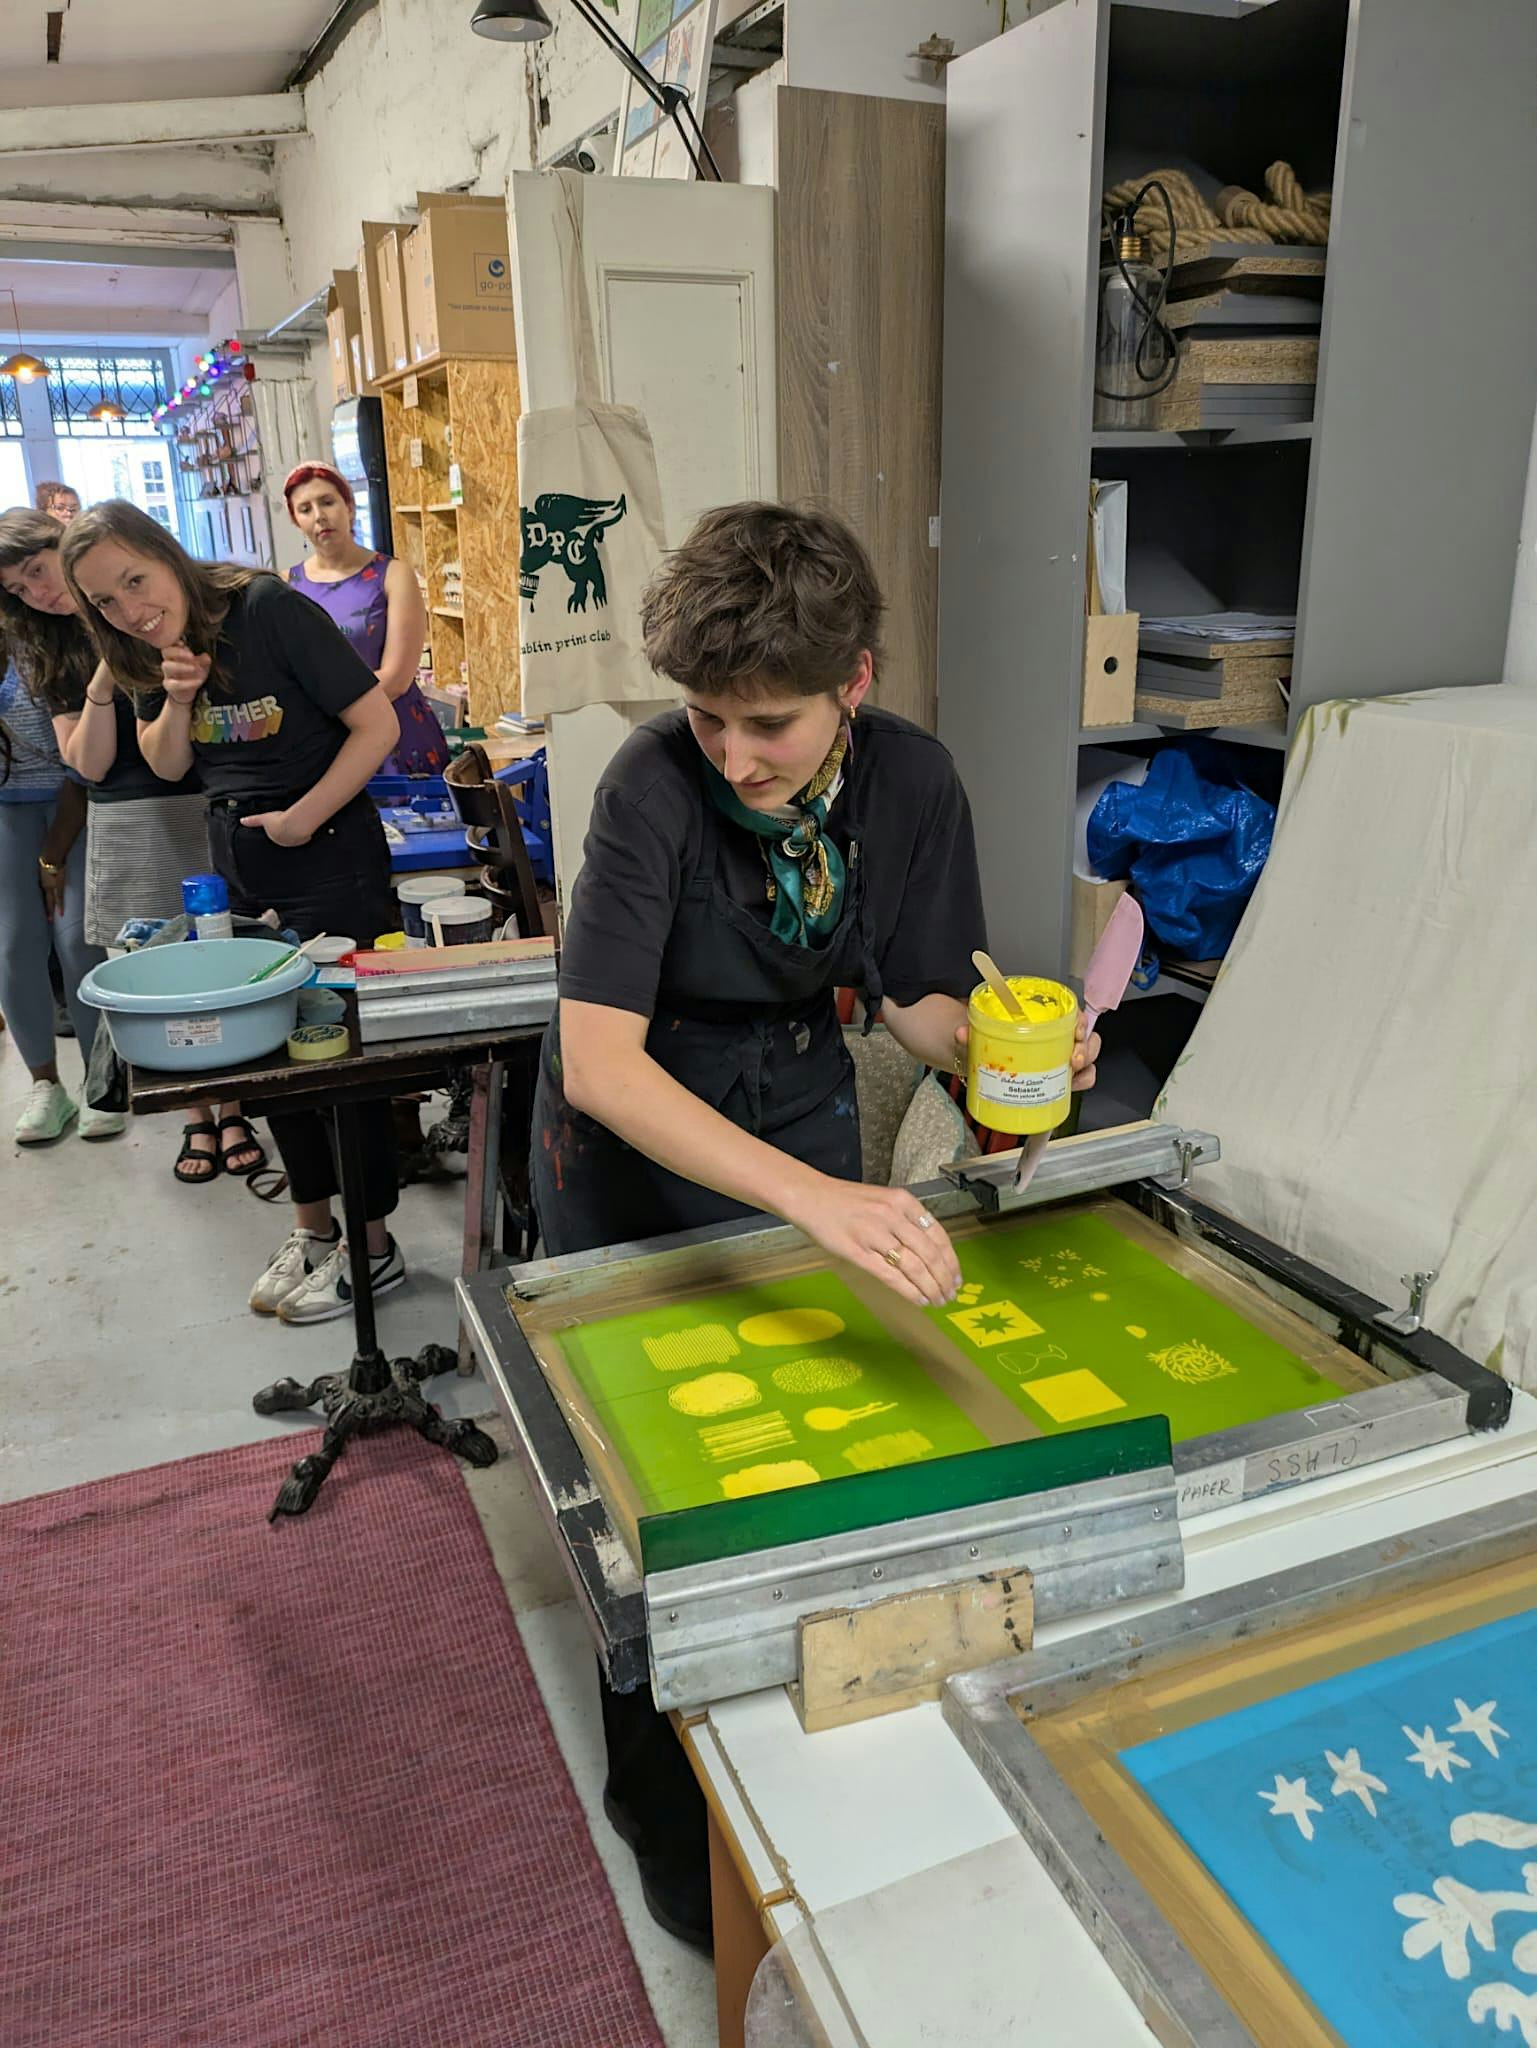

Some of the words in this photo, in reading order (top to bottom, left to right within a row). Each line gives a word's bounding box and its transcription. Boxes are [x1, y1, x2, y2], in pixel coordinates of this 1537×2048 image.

[526, 522, 587, 566] DPC
[521, 640, 552, 655] ublin
[555, 634, 587, 653] print
[589, 629, 611, 643] club
